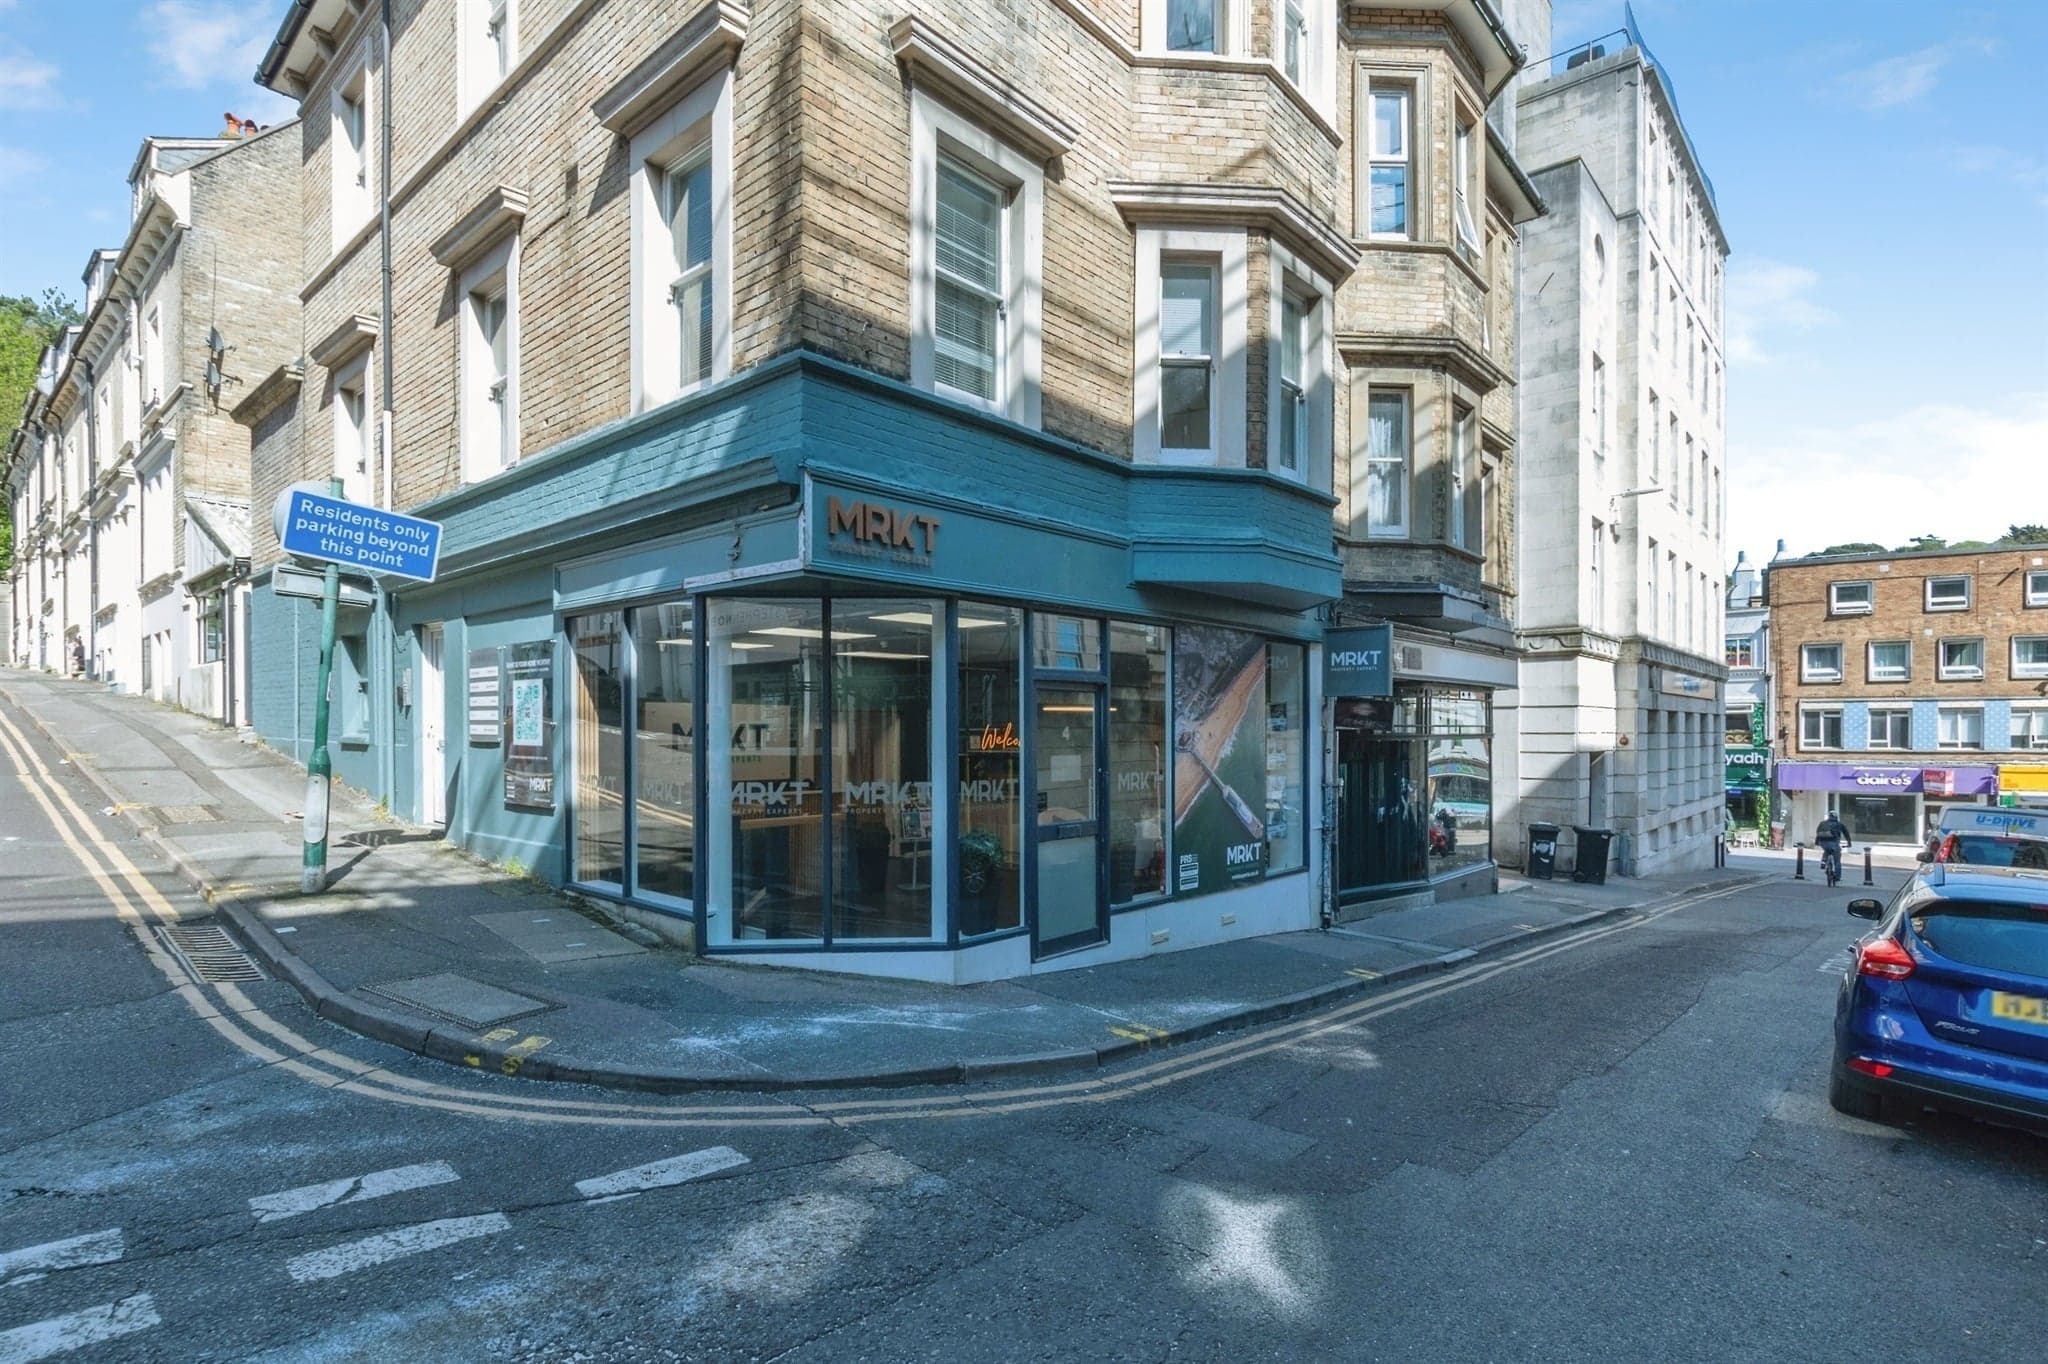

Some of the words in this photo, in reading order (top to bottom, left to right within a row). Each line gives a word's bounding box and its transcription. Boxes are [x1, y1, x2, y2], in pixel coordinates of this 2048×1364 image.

[301, 499, 390, 531] Residents
[394, 524, 430, 543] only
[827, 495, 942, 553] MRKT
[296, 518, 364, 545] parking
[368, 531, 430, 556] beyond
[320, 537, 354, 556] this
[358, 547, 404, 567] point
[1331, 650, 1381, 666] MRKT
[671, 722, 769, 751] MKT
[981, 721, 1021, 750] Welco
[1725, 752, 1764, 766] yadh
[844, 781, 933, 806] MRKT
[960, 778, 1019, 804] MRKT
[1118, 770, 1160, 792] MRKT
[1975, 814, 2037, 829] U-DRIVE
[1227, 842, 1262, 866] MRKT
